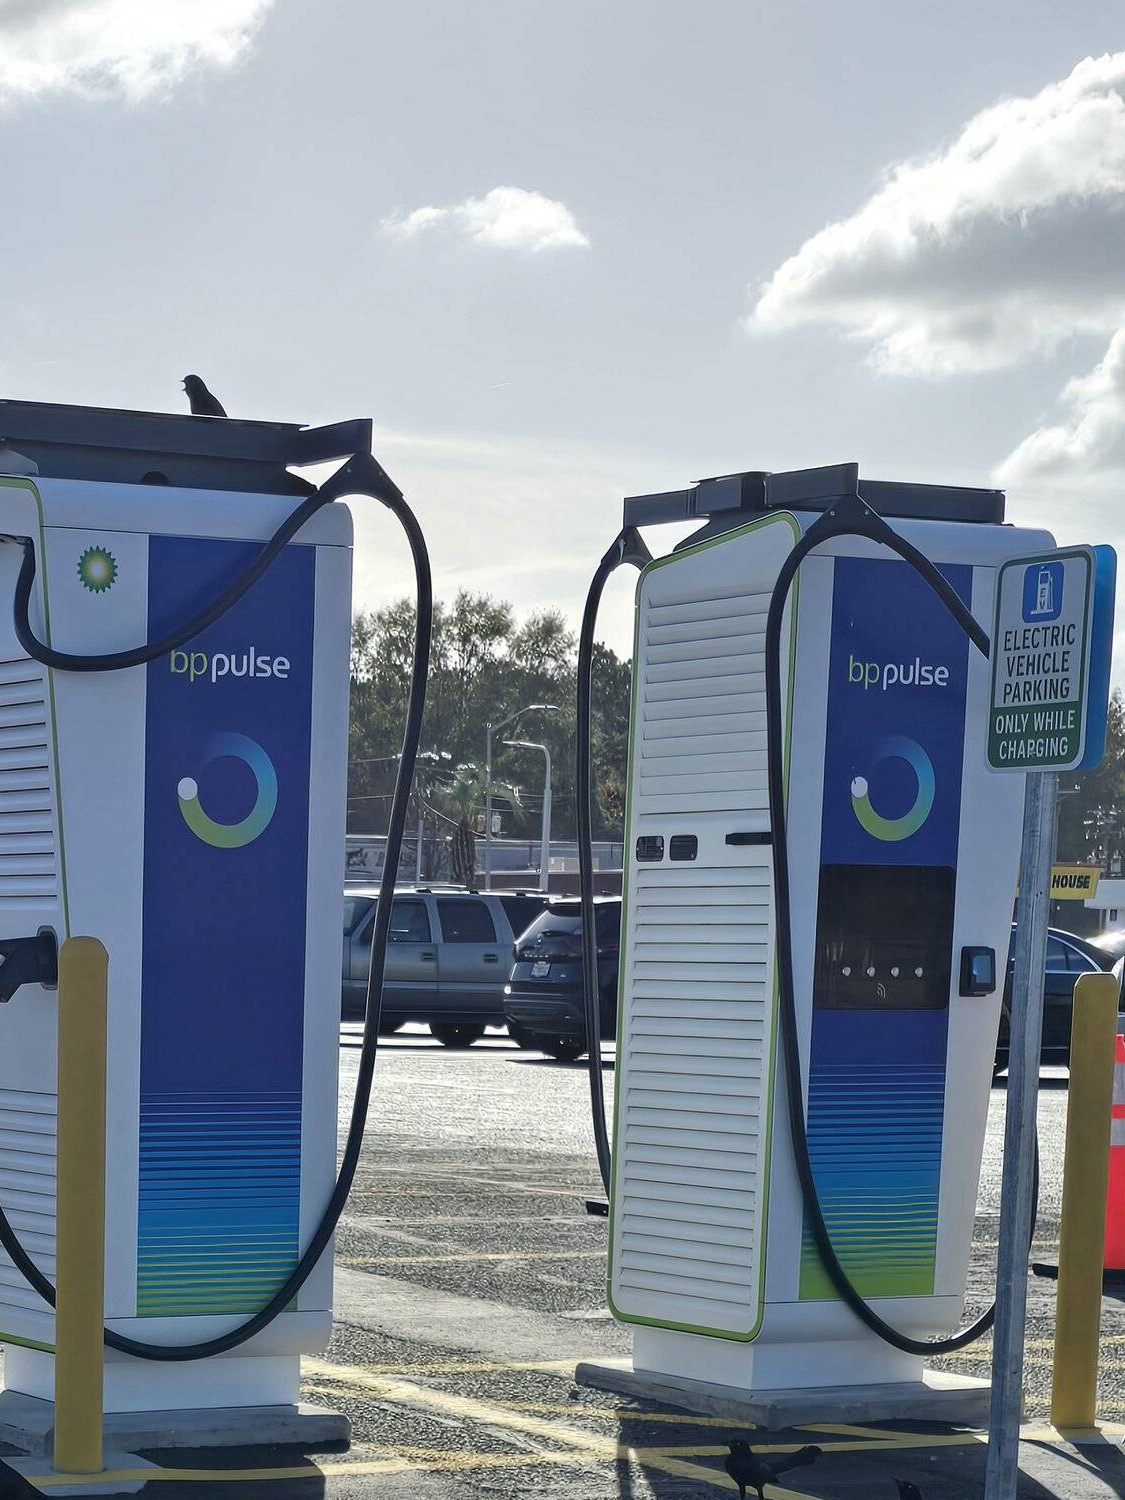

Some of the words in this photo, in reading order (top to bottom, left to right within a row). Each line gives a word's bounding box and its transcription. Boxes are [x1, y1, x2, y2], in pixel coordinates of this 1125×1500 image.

[1004, 624, 1076, 651] ELECTRIC
[1006, 650, 1070, 677] VEHICLE
[1003, 677, 1070, 704] PARKING
[995, 713, 1029, 735] ONLY
[1033, 709, 1075, 731] WHILE
[998, 736, 1068, 760] CHARGING
[1051, 874, 1092, 889] HOUSE
